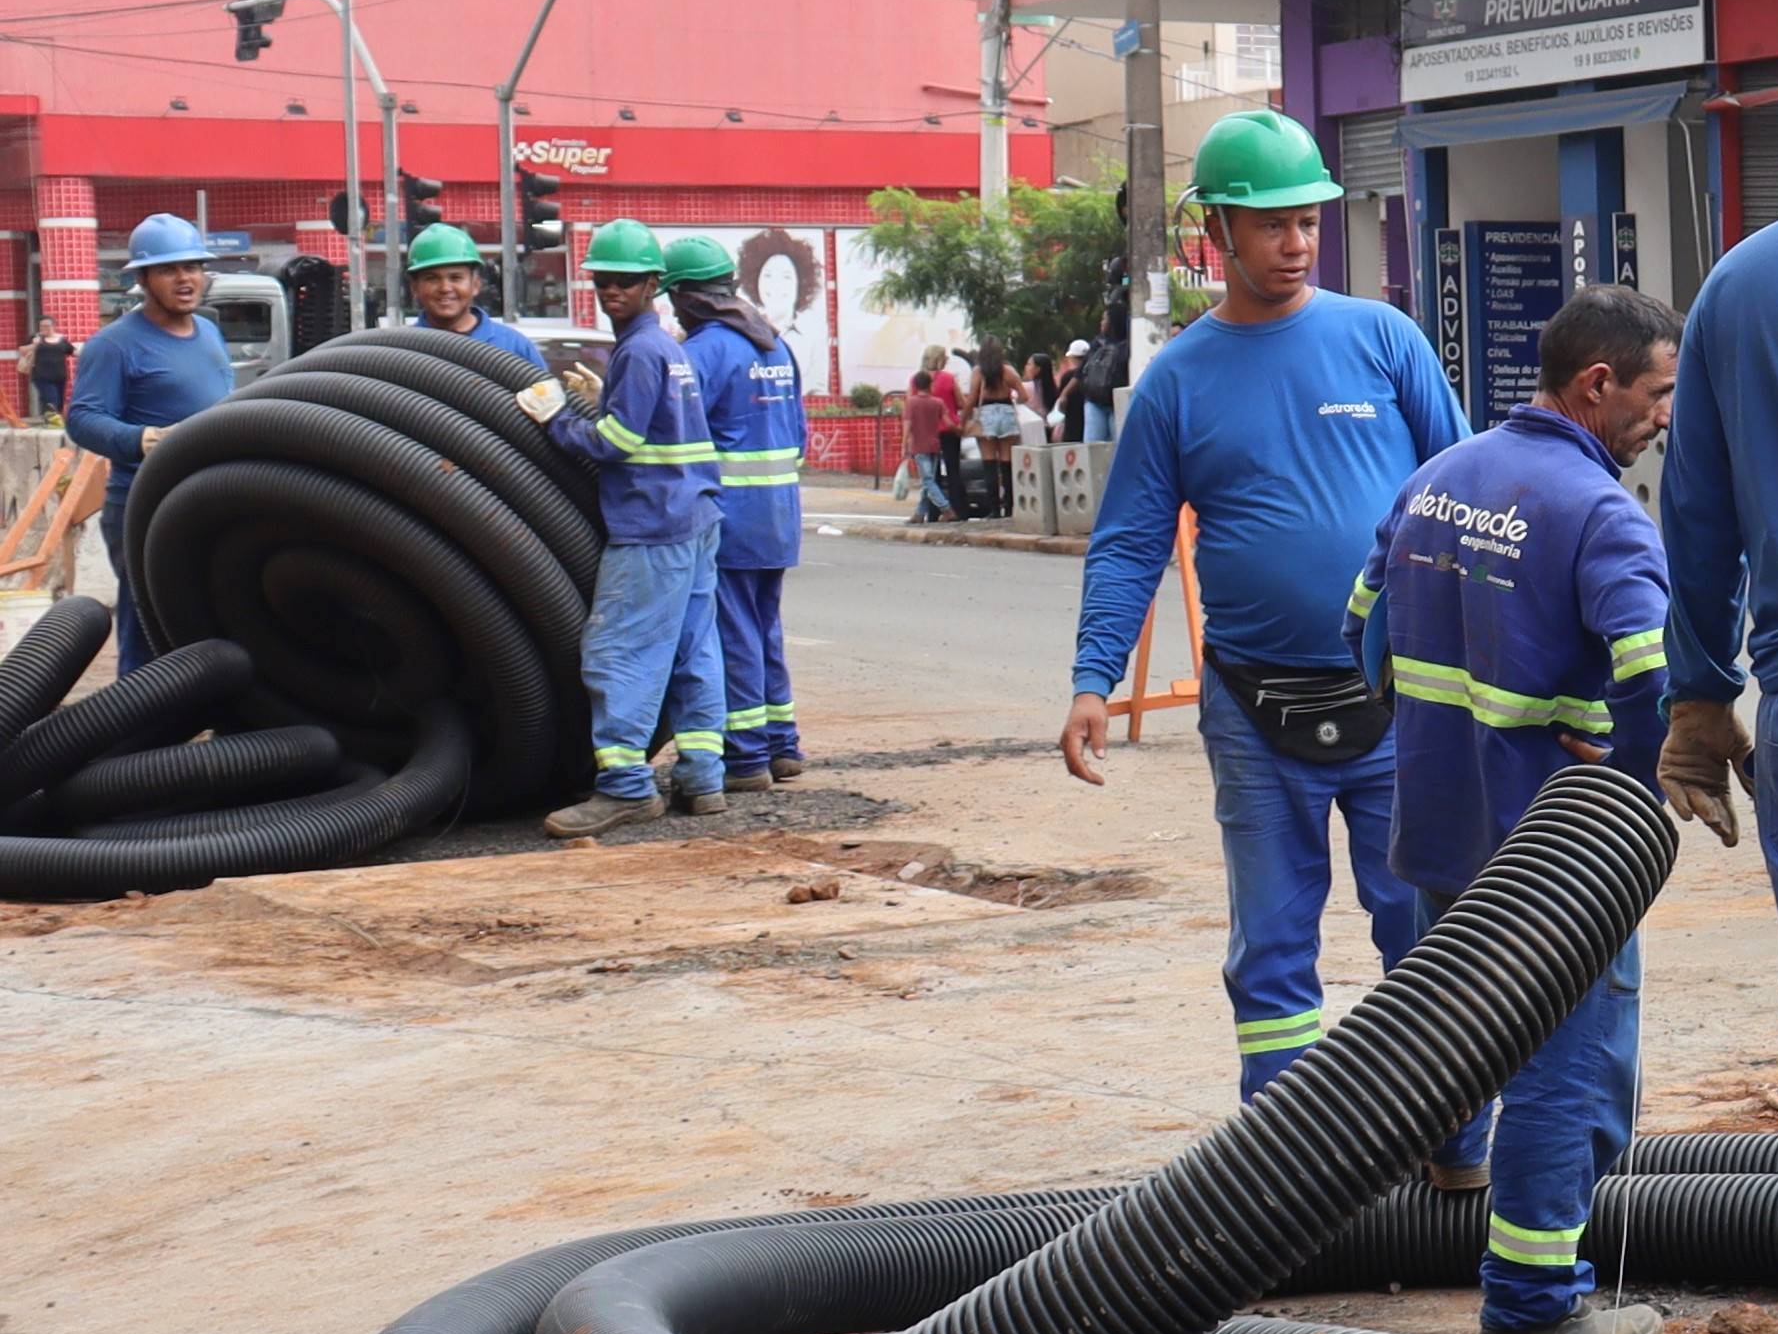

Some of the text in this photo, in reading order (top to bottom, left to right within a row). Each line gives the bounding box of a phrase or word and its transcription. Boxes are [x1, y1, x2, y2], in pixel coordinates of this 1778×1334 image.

[1409, 13, 1694, 69] APOSENTADORIAS, BENEFÍCIOS, AUXÍLIOS E REVISÕES
[529, 140, 613, 169] Super
[1408, 483, 1529, 542] eletrorede
[1459, 534, 1522, 561] engenharia
